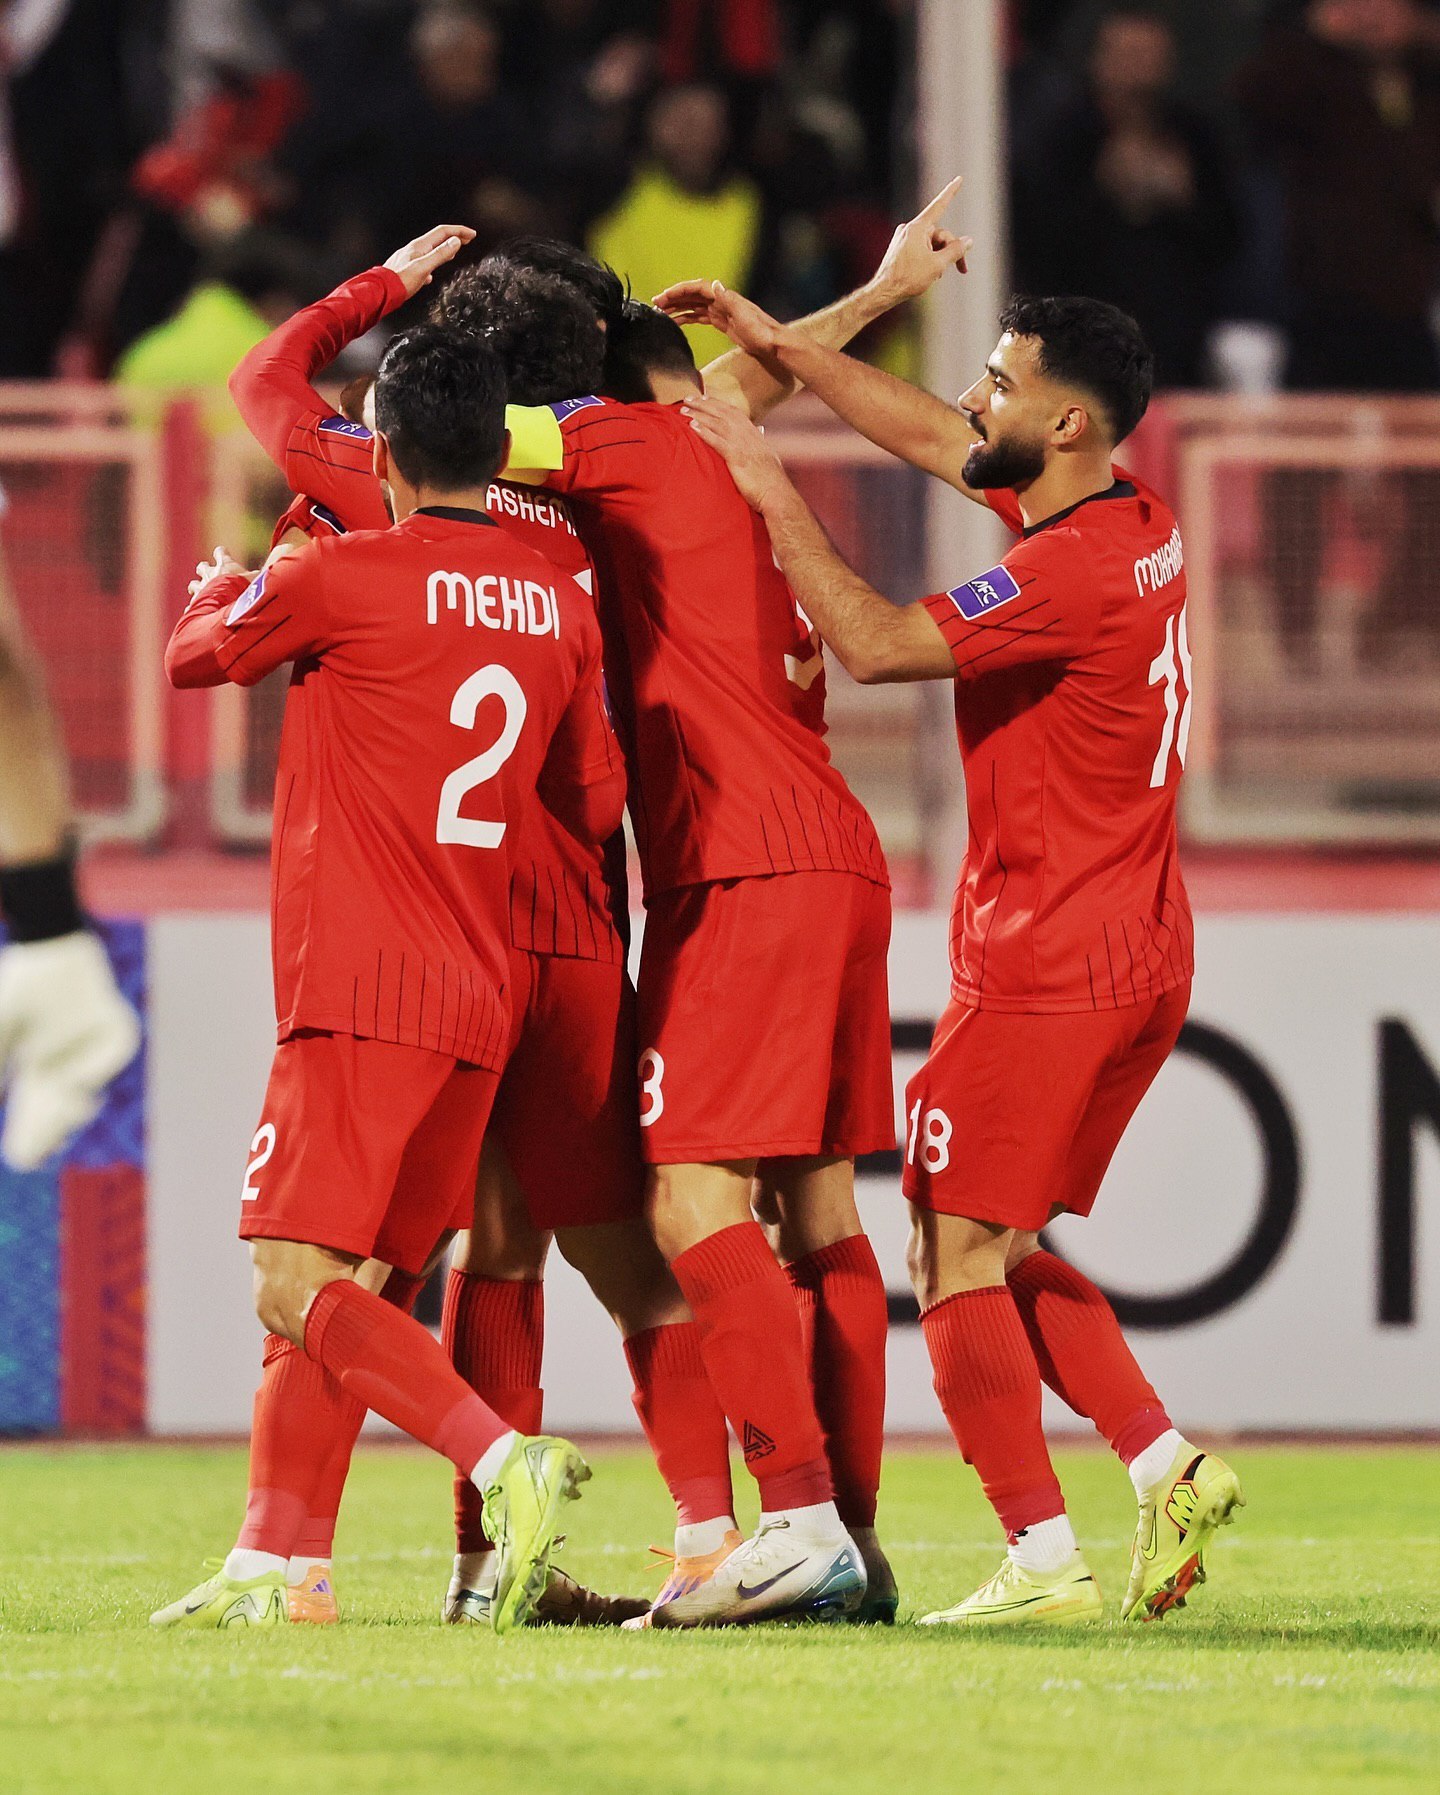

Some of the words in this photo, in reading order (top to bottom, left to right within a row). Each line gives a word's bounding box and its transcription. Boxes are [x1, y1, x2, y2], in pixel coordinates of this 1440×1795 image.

[427, 570, 560, 640] MEHDI
[970, 580, 1001, 605] AFC
[436, 663, 527, 849] 2
[240, 1122, 276, 1201] 2
[907, 1098, 953, 1173] 18
